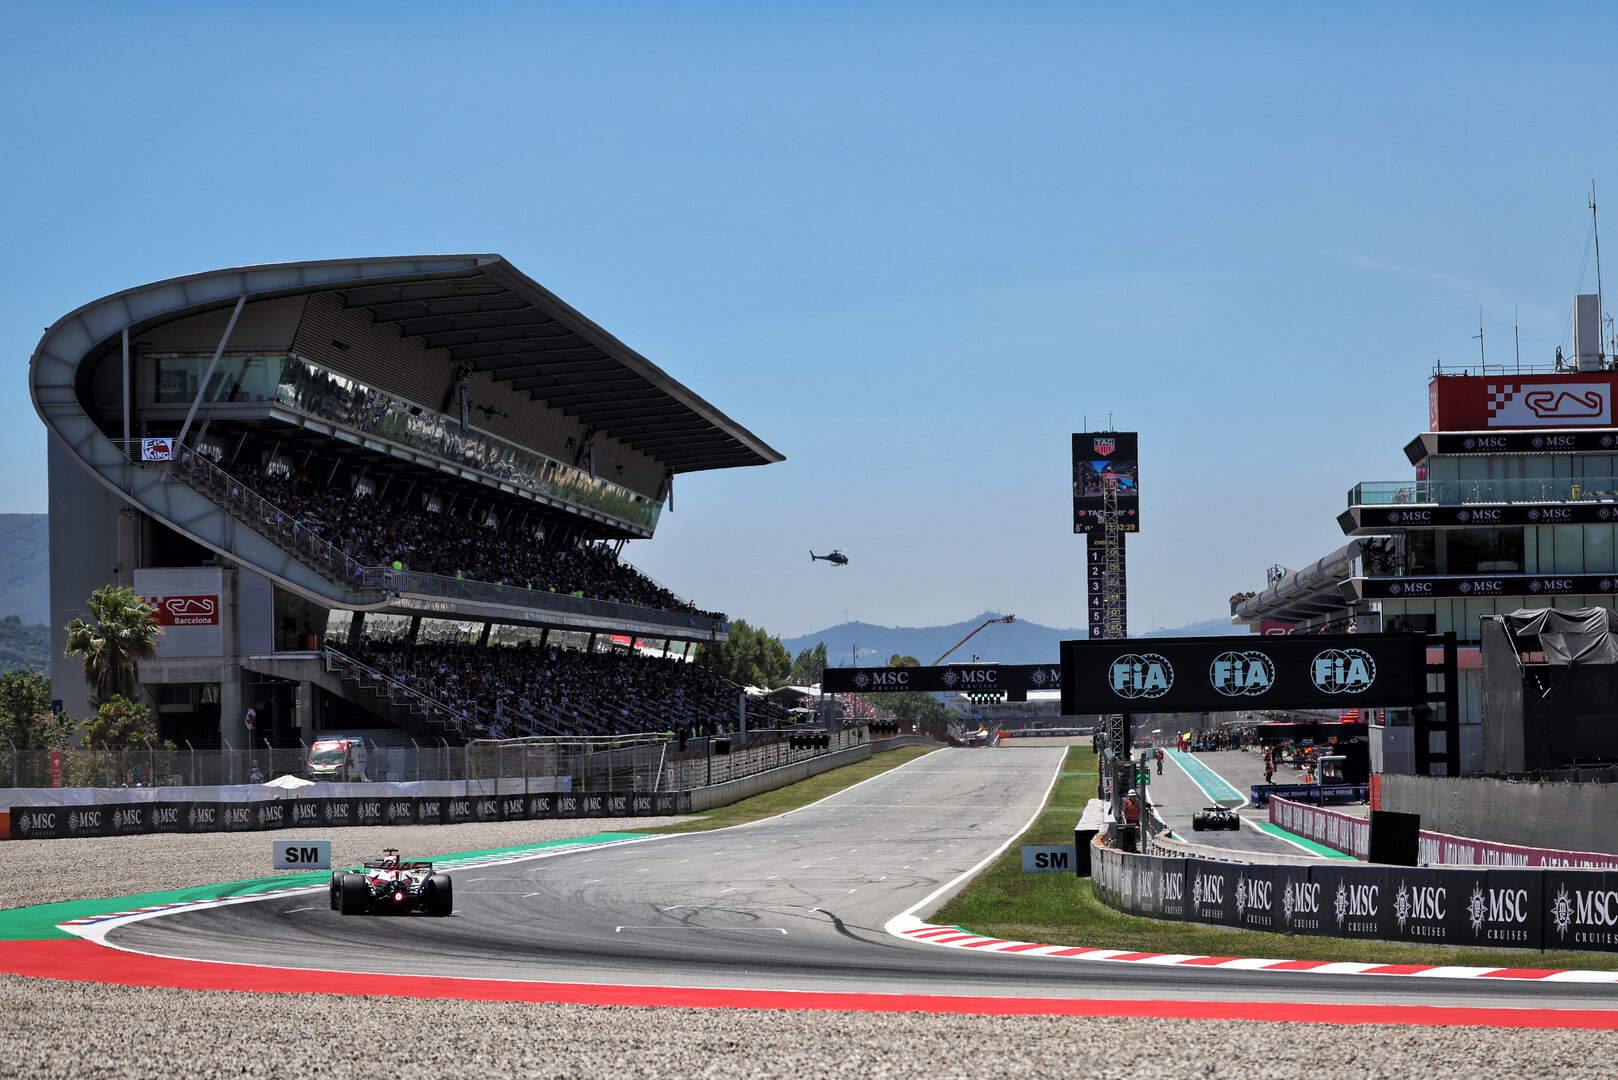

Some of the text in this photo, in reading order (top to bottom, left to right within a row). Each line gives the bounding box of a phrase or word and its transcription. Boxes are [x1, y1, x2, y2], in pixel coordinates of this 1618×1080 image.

[1478, 438, 1506, 447] MSC
[1546, 436, 1574, 446] MSC
[1402, 511, 1430, 520] MSC
[1473, 510, 1500, 519] MSC
[1543, 509, 1570, 517] MSC
[1093, 552, 1097, 560] 1
[1093, 582, 1099, 590] 3
[1404, 583, 1432, 592] MSC
[1474, 581, 1502, 590] MSC
[1544, 580, 1572, 589] MSC
[1094, 612, 1099, 620] 5
[1094, 627, 1099, 635] 6
[873, 672, 908, 684] MSC
[962, 670, 997, 682] MSC
[334, 804, 348, 817] MSC
[365, 803, 380, 816] MSC
[396, 803, 410, 816] MSC
[425, 803, 440, 816] MSC
[455, 802, 470, 815] MSC
[509, 800, 523, 813] MSC
[564, 798, 576, 810] MSC
[123, 810, 141, 824] MSC
[161, 809, 177, 822] MSC
[197, 809, 215, 822] MSC
[232, 808, 249, 822] MSC
[266, 806, 283, 820] MSC
[300, 804, 317, 818] MSC
[32, 814, 56, 828] MSC
[79, 812, 100, 827] MSC
[285, 847, 318, 862] SM
[1035, 853, 1068, 868] SM
[1166, 873, 1182, 900] MSC
[1203, 875, 1224, 904] MSC
[1248, 879, 1272, 910] MSC
[1295, 883, 1320, 912] MSC
[1349, 885, 1378, 916] MSC
[1412, 887, 1446, 919] MSC
[1488, 889, 1527, 922] MSC
[1576, 891, 1618, 926] MSC
[1202, 909, 1223, 918] CRUISES
[1247, 915, 1271, 925] CRUISES
[1294, 919, 1319, 928] CRUISES
[1348, 922, 1377, 932] CRUISES
[1411, 926, 1446, 936] CRUISES
[1488, 929, 1527, 940] CRUISES
